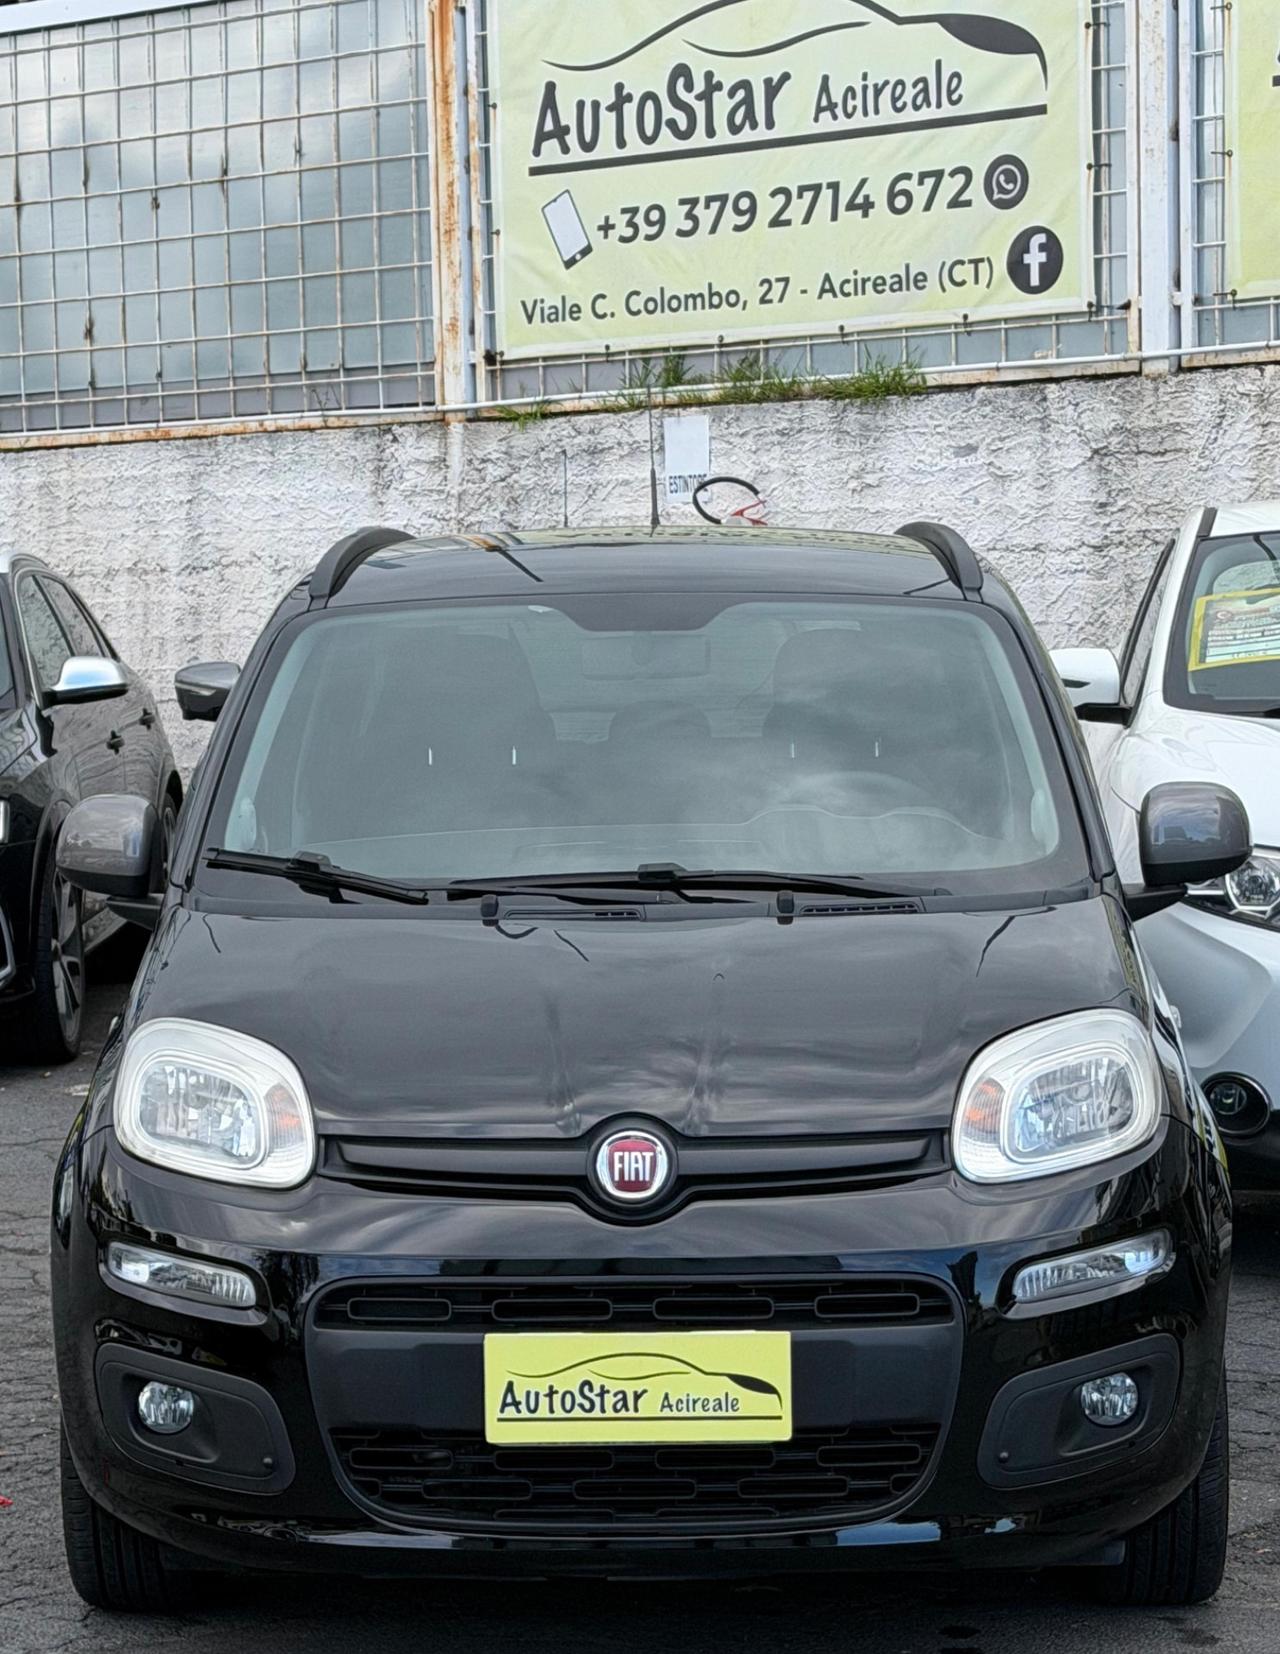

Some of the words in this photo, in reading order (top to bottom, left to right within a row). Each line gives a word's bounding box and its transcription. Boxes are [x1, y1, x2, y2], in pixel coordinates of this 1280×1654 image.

[532, 62, 792, 158] AutoStar
[812, 58, 964, 123] Acireale
[597, 203, 666, 244] +39
[676, 190, 758, 239] 379
[767, 177, 875, 229] 2714
[886, 165, 973, 216] 672
[521, 297, 582, 325] Viale
[591, 293, 616, 320] C.
[625, 282, 748, 318] Colombo,
[758, 277, 790, 305] 27
[817, 262, 928, 300] Acireale
[938, 256, 994, 293] (CT)
[613, 1151, 654, 1182] FIAT
[500, 1379, 649, 1414] AutoStar
[659, 1392, 741, 1413] Acireale
